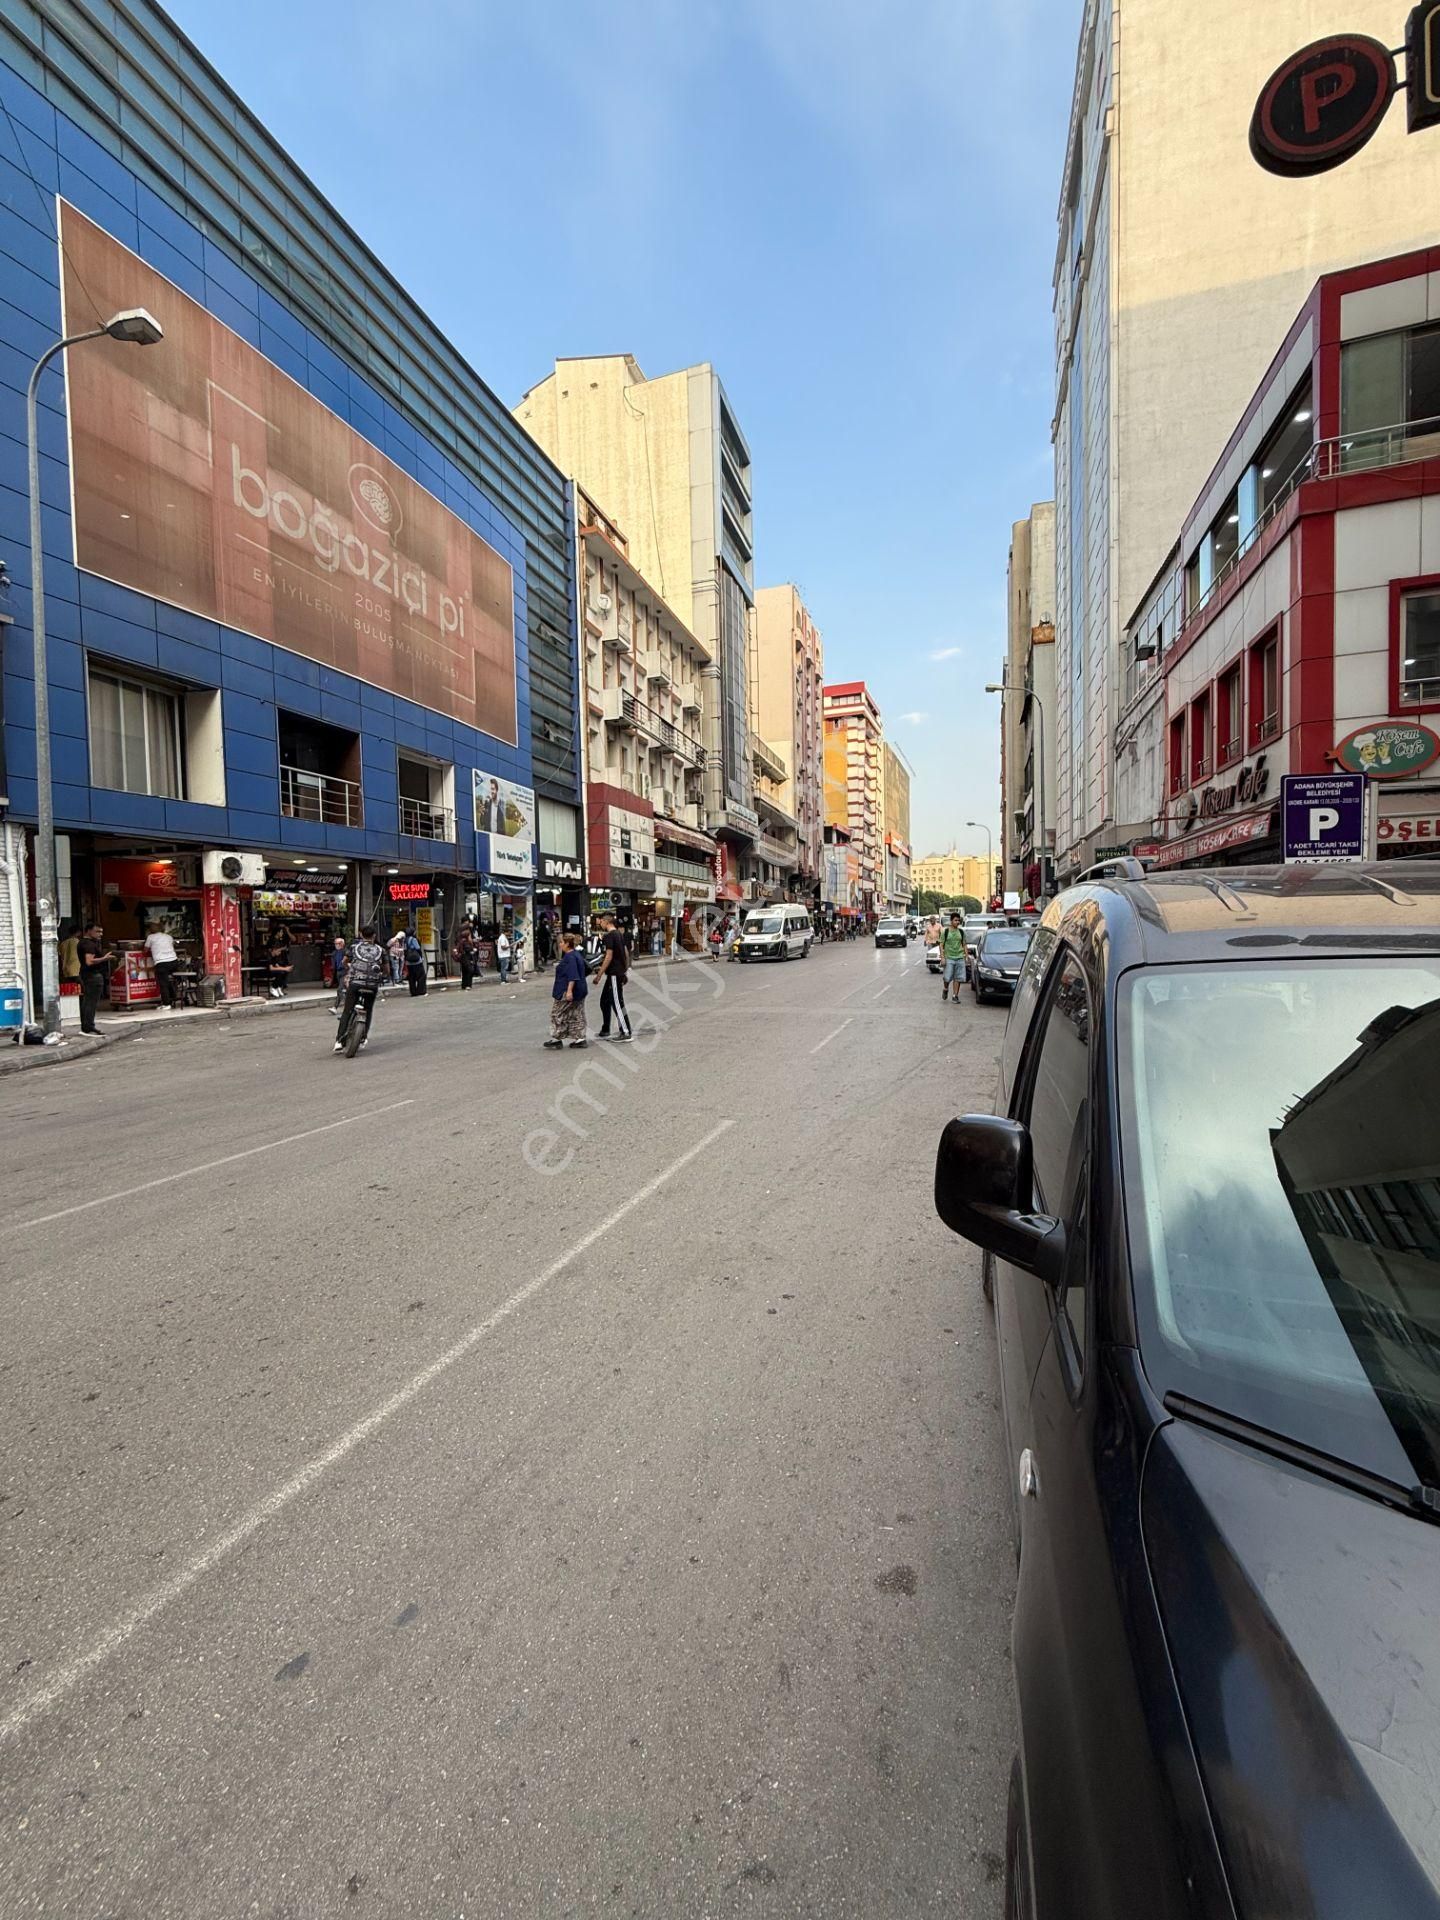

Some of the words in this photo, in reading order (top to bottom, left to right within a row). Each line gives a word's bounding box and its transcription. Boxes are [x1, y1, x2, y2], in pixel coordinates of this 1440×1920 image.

[1300, 62, 1357, 134] P
[231, 442, 428, 616] boğaziçi
[439, 592, 465, 638] pi
[252, 567, 276, 588] EN
[282, 577, 349, 625] İYİLERİN
[354, 592, 392, 623] 2005
[1375, 728, 1420, 744] Köşem
[1394, 739, 1425, 759] Cafe
[1294, 782, 1315, 790] ADANA
[1315, 781, 1354, 790] BÜYÜKŞEHİR
[1306, 789, 1341, 797] BELEDİYESİ
[1309, 807, 1340, 841] P
[1377, 818, 1440, 842] ÖŞE
[1293, 842, 1313, 850] ADET
[1314, 841, 1337, 849] TİCARİ
[1338, 841, 1359, 849] TAKSİ
[1297, 849, 1331, 857] BEKLEME
[1332, 848, 1349, 856] YERİ
[389, 883, 410, 893] ÇİLEK
[411, 883, 430, 892] SUYU
[391, 891, 428, 901] ŞALGAM
